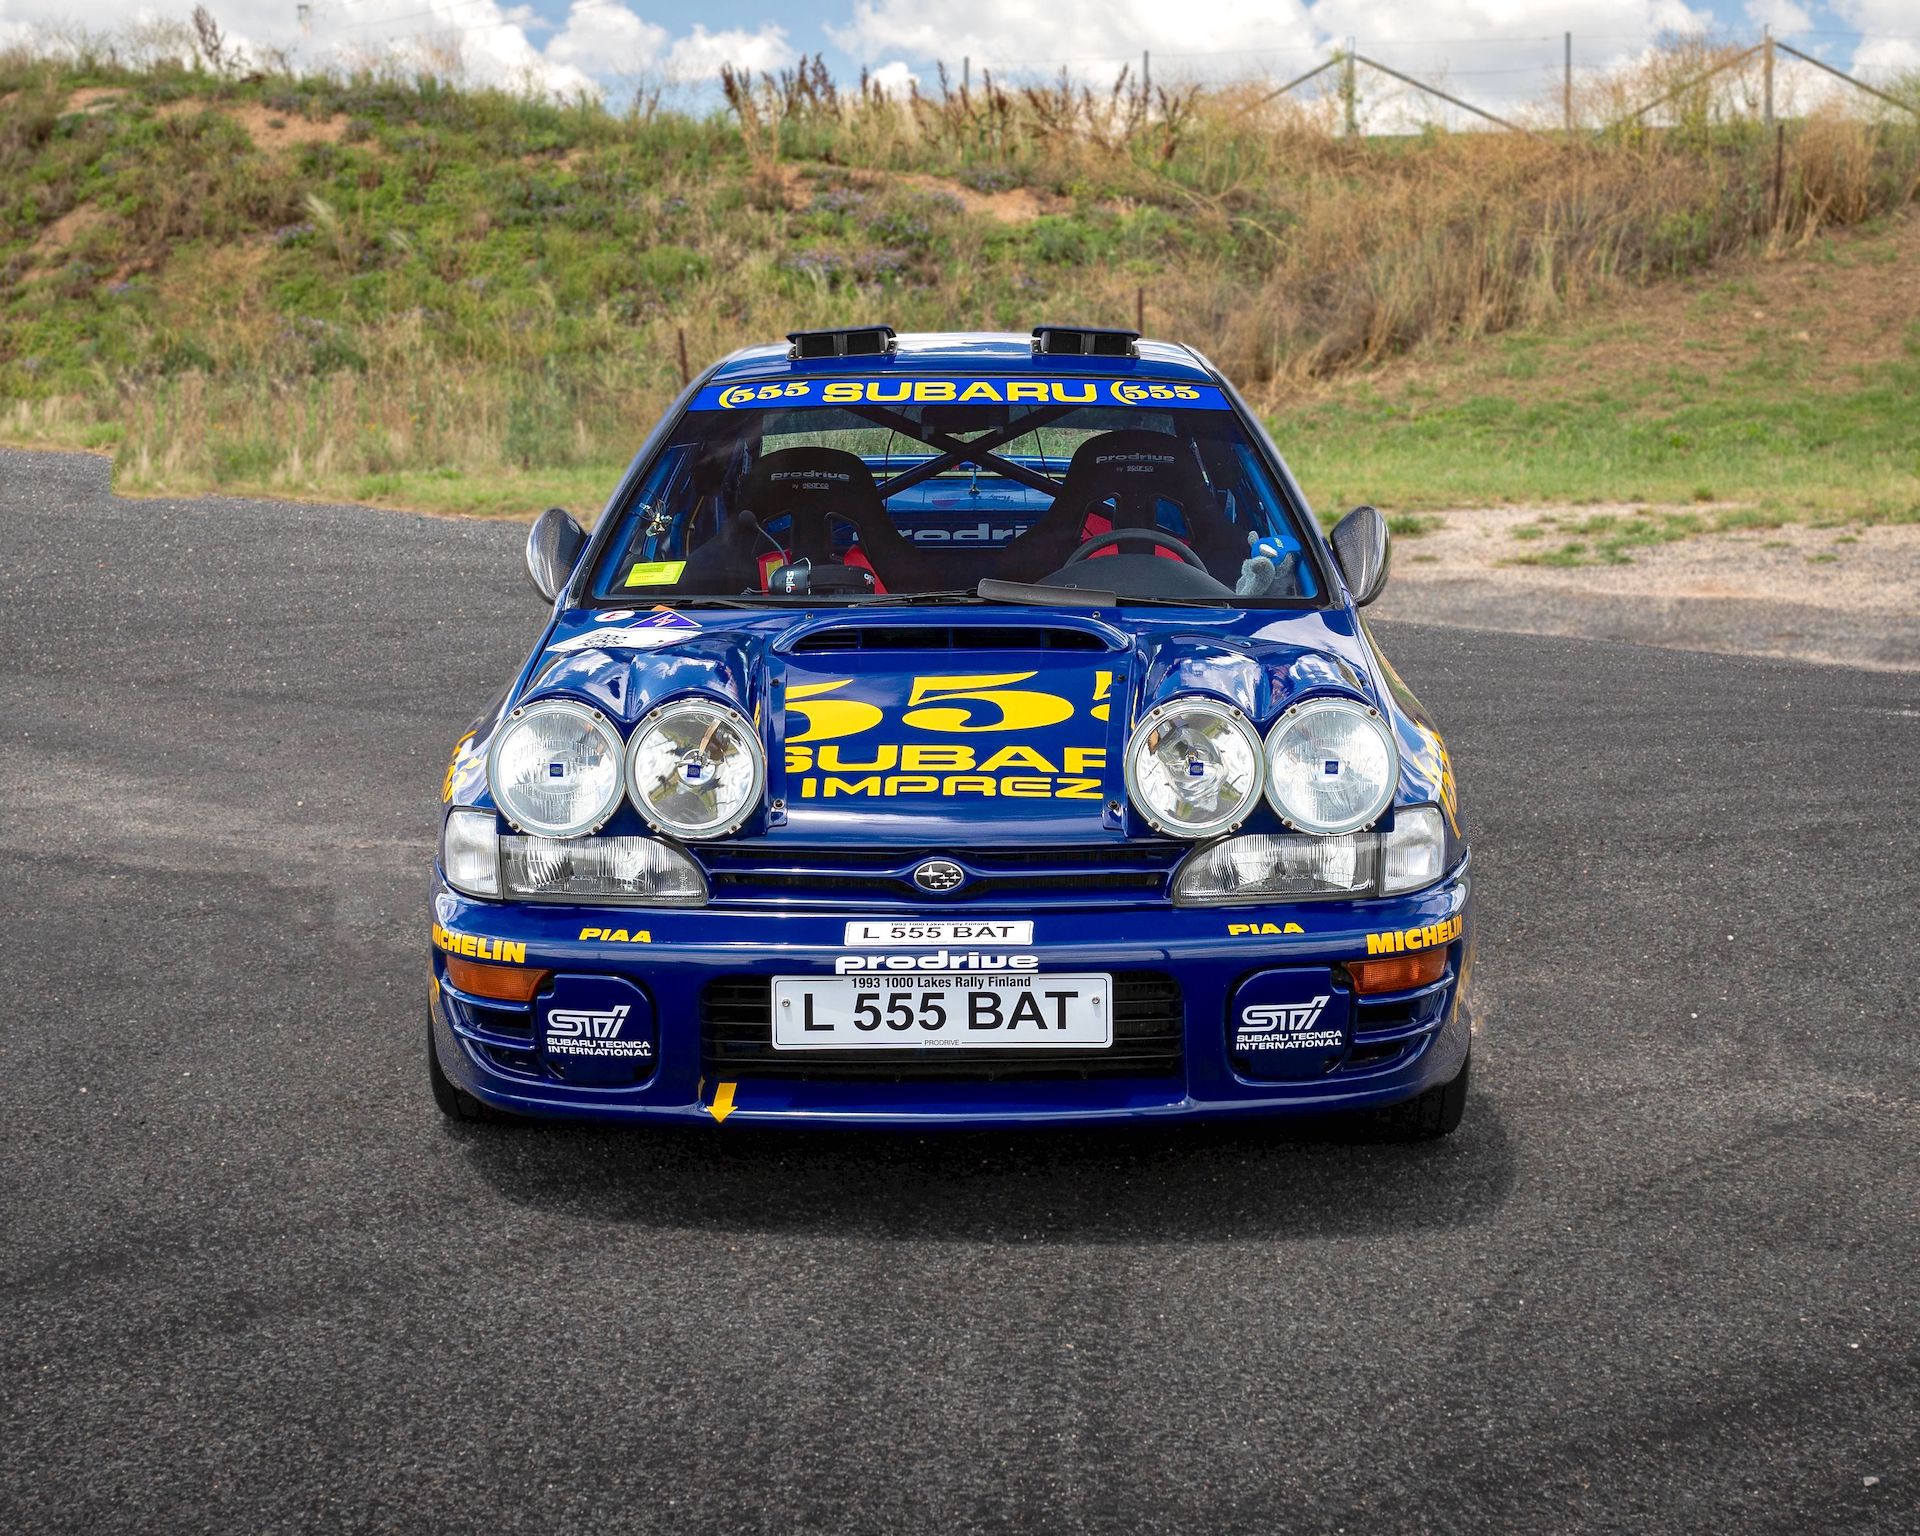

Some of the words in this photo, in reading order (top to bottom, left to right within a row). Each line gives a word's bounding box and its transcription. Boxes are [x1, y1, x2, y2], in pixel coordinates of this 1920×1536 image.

[822, 381, 1097, 403] SUBARU
[1096, 453, 1175, 464] prodrive
[770, 470, 850, 481] prodrive
[863, 927, 879, 939] L
[891, 927, 942, 939] 555
[953, 926, 1015, 938] BAT
[1227, 922, 1305, 935] PIAA
[1366, 914, 1462, 954] MICHELIN
[578, 928, 653, 943] PIAA
[835, 950, 1039, 974] prodrive
[851, 977, 881, 989] 1993
[884, 977, 914, 989] 1000
[917, 976, 951, 988] Lakes
[955, 976, 984, 989] Rally
[988, 976, 1031, 988] Finland
[804, 993, 834, 1031] L
[853, 993, 947, 1031] 555
[968, 991, 1079, 1030] BAT
[546, 1037, 597, 1048] SUBARU
[598, 1040, 651, 1049] TECNICA
[1236, 1033, 1289, 1043] SUBARU
[1290, 1030, 1343, 1041] TECNICA
[548, 1046, 652, 1057] INTERNATIONAL
[1235, 1039, 1342, 1051] INTERNATIONAL
